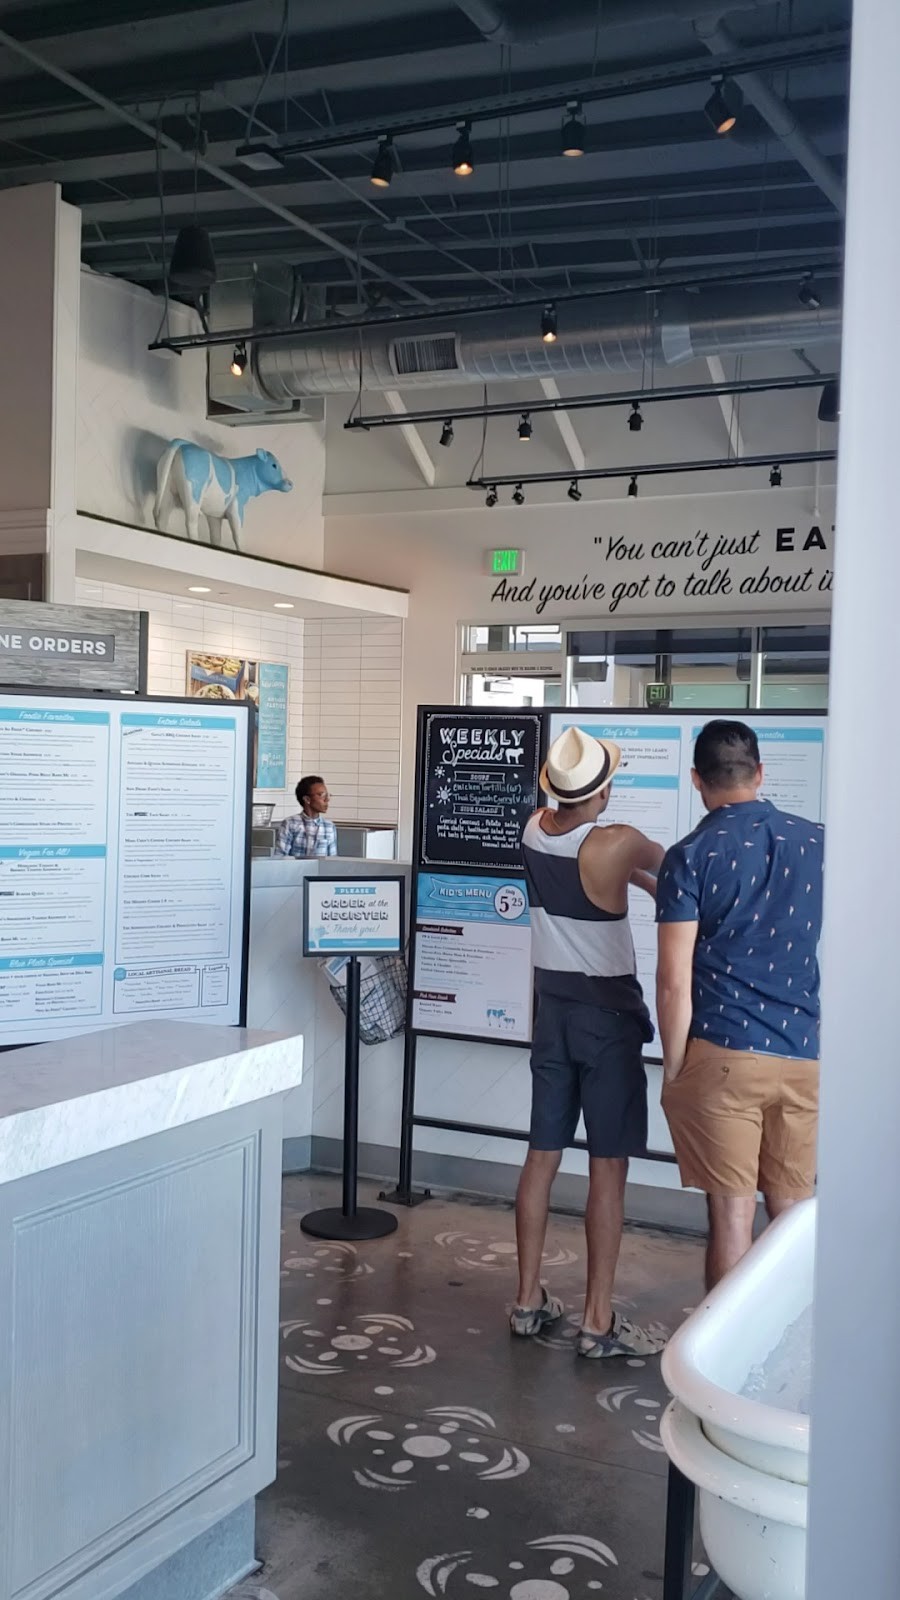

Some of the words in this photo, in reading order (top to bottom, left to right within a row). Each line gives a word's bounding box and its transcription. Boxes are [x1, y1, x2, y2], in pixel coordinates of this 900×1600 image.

[651, 529, 709, 559] can't
[701, 529, 761, 571] just
[775, 524, 835, 552] EA
[493, 550, 518, 572] EXIT
[491, 577, 537, 602] And
[535, 574, 606, 614] you've
[608, 574, 650, 612] got
[654, 573, 676, 597] to
[683, 567, 733, 596] talk
[739, 566, 814, 594] about
[29, 636, 106, 655] ORDERS
[440, 727, 525, 746] WEEKLY
[602, 728, 624, 738] Chef's
[442, 741, 505, 767] Specials
[440, 887, 463, 896] KID'S
[465, 889, 492, 898] MENU
[321, 899, 366, 909] ORDER
[378, 899, 389, 907] the
[321, 911, 389, 921] REGISTER
[332, 923, 357, 934] Thank
[359, 924, 381, 937] you!
